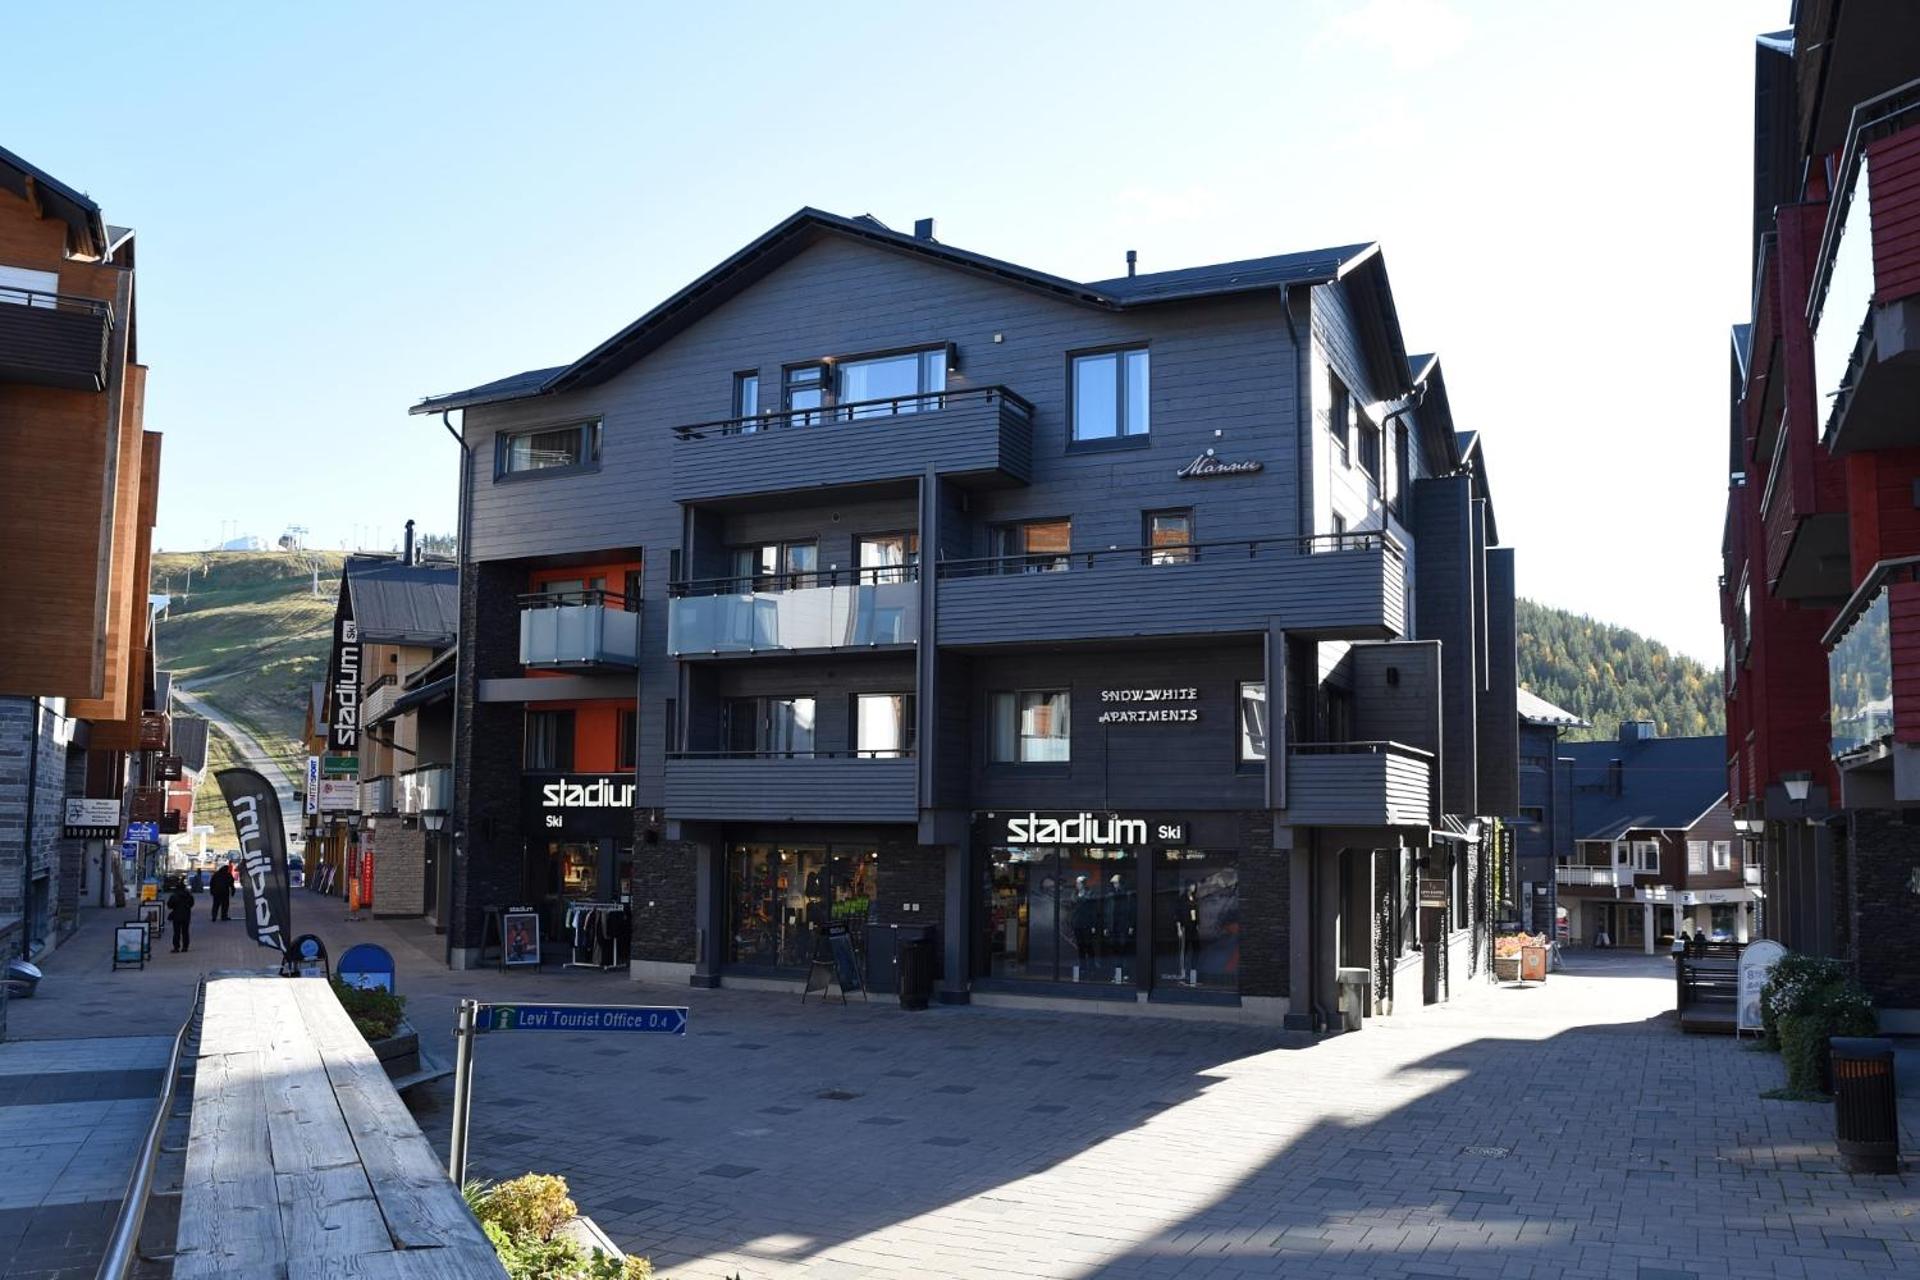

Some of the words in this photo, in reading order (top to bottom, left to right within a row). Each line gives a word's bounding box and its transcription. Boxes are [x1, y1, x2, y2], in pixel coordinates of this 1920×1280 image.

[346, 623, 356, 640] Ski
[334, 647, 359, 745] stadium
[1101, 690, 1144, 702] SNOW
[1145, 688, 1197, 701] WHITE
[1099, 709, 1198, 722] APARTMENTS
[545, 815, 563, 828] Ski
[1007, 812, 1147, 845] stadium
[1158, 825, 1181, 839] Ski
[519, 1011, 548, 1025] Levi
[552, 1011, 599, 1026] Tourist
[603, 1013, 643, 1028] Office
[650, 1013, 668, 1028] 0.4
